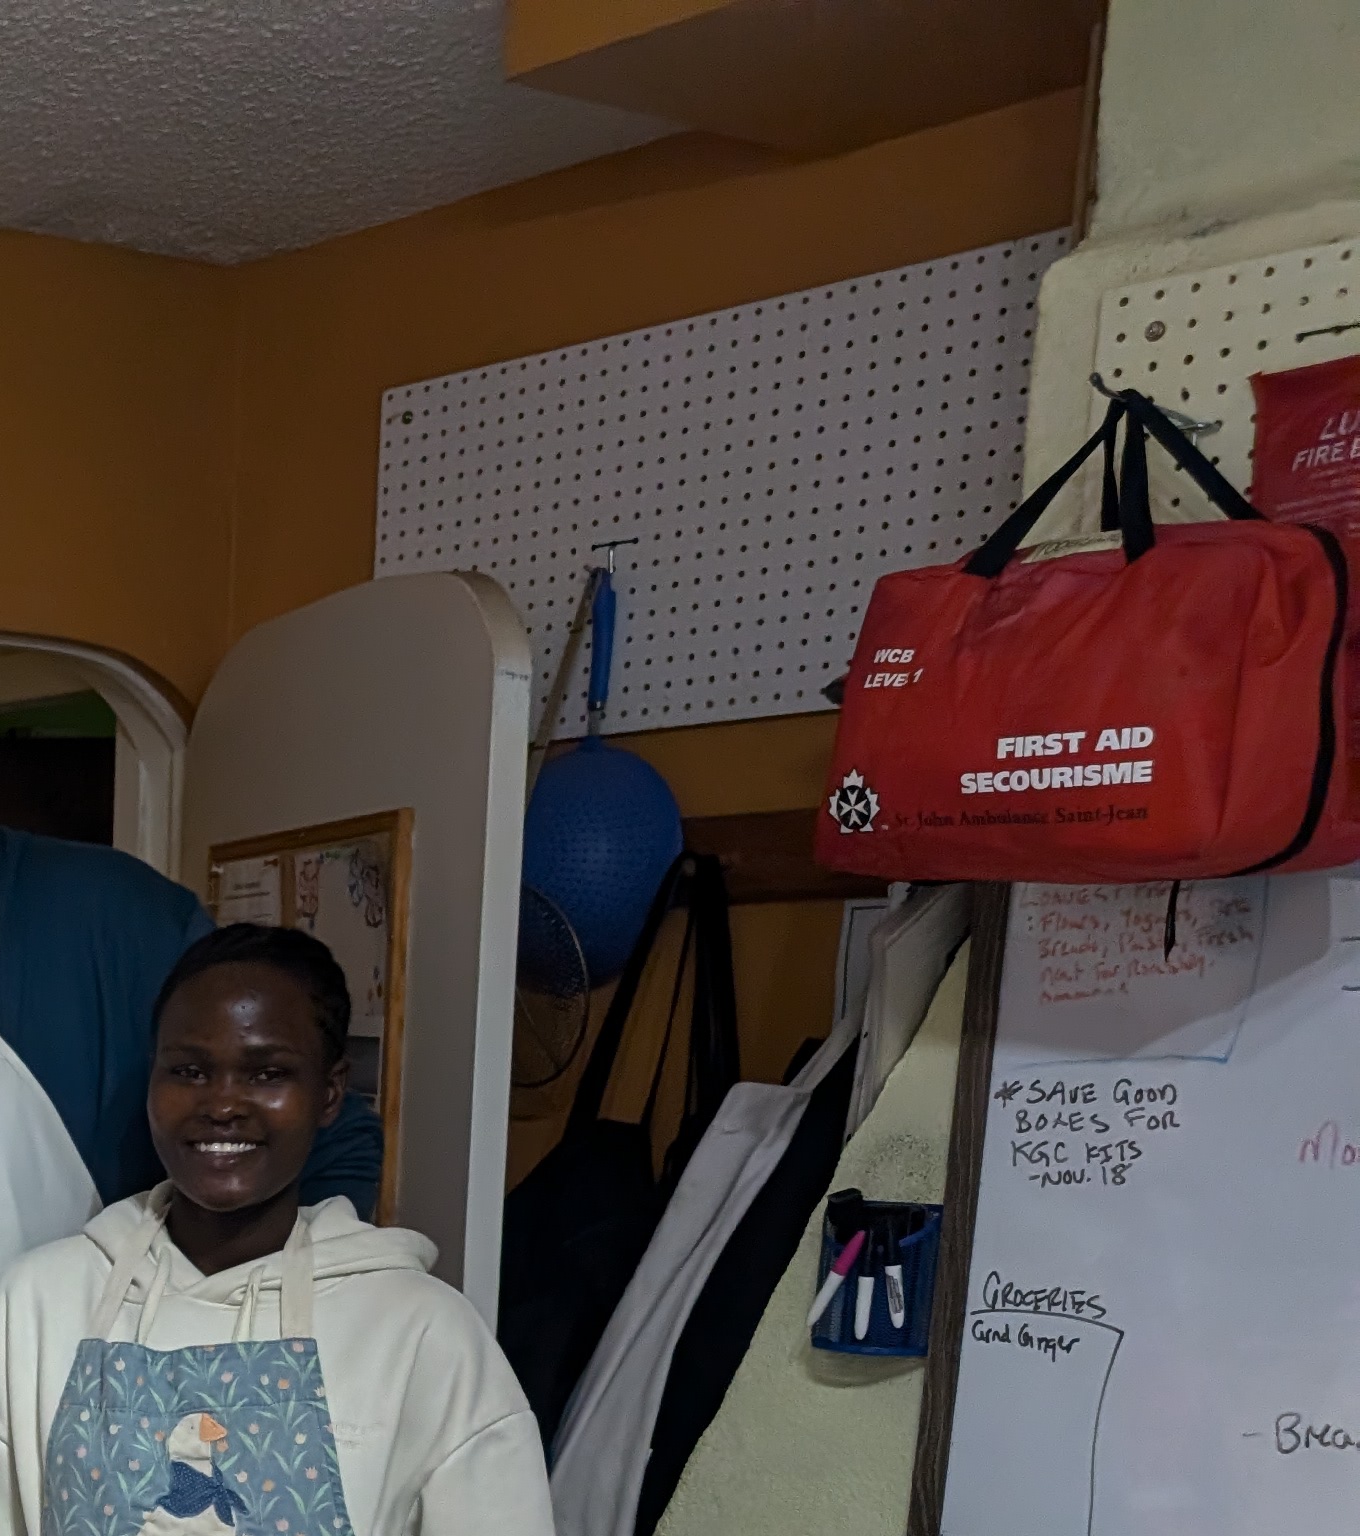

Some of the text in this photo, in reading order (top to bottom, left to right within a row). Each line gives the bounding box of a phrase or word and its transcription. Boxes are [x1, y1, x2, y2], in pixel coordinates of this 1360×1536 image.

[1292, 442, 1345, 471] FIRE
[873, 648, 915, 663] WCB
[913, 668, 924, 683] 1
[997, 726, 1154, 760] FIRST AID
[960, 760, 1153, 794] SECOURISME
[917, 811, 954, 832] John
[958, 809, 1048, 828] Ambulance
[1055, 805, 1149, 831] Saint-Jean
[1026, 1079, 1097, 1105] SAVE
[1015, 1106, 1180, 1133] BOXES FOR
[1011, 1139, 1143, 1166] KGC KITS
[1101, 1162, 1132, 1185] 18
[982, 1270, 1107, 1319] GROCERIES
[1018, 1323, 1080, 1363] Ginger
[1275, 1411, 1360, 1454] Brea
